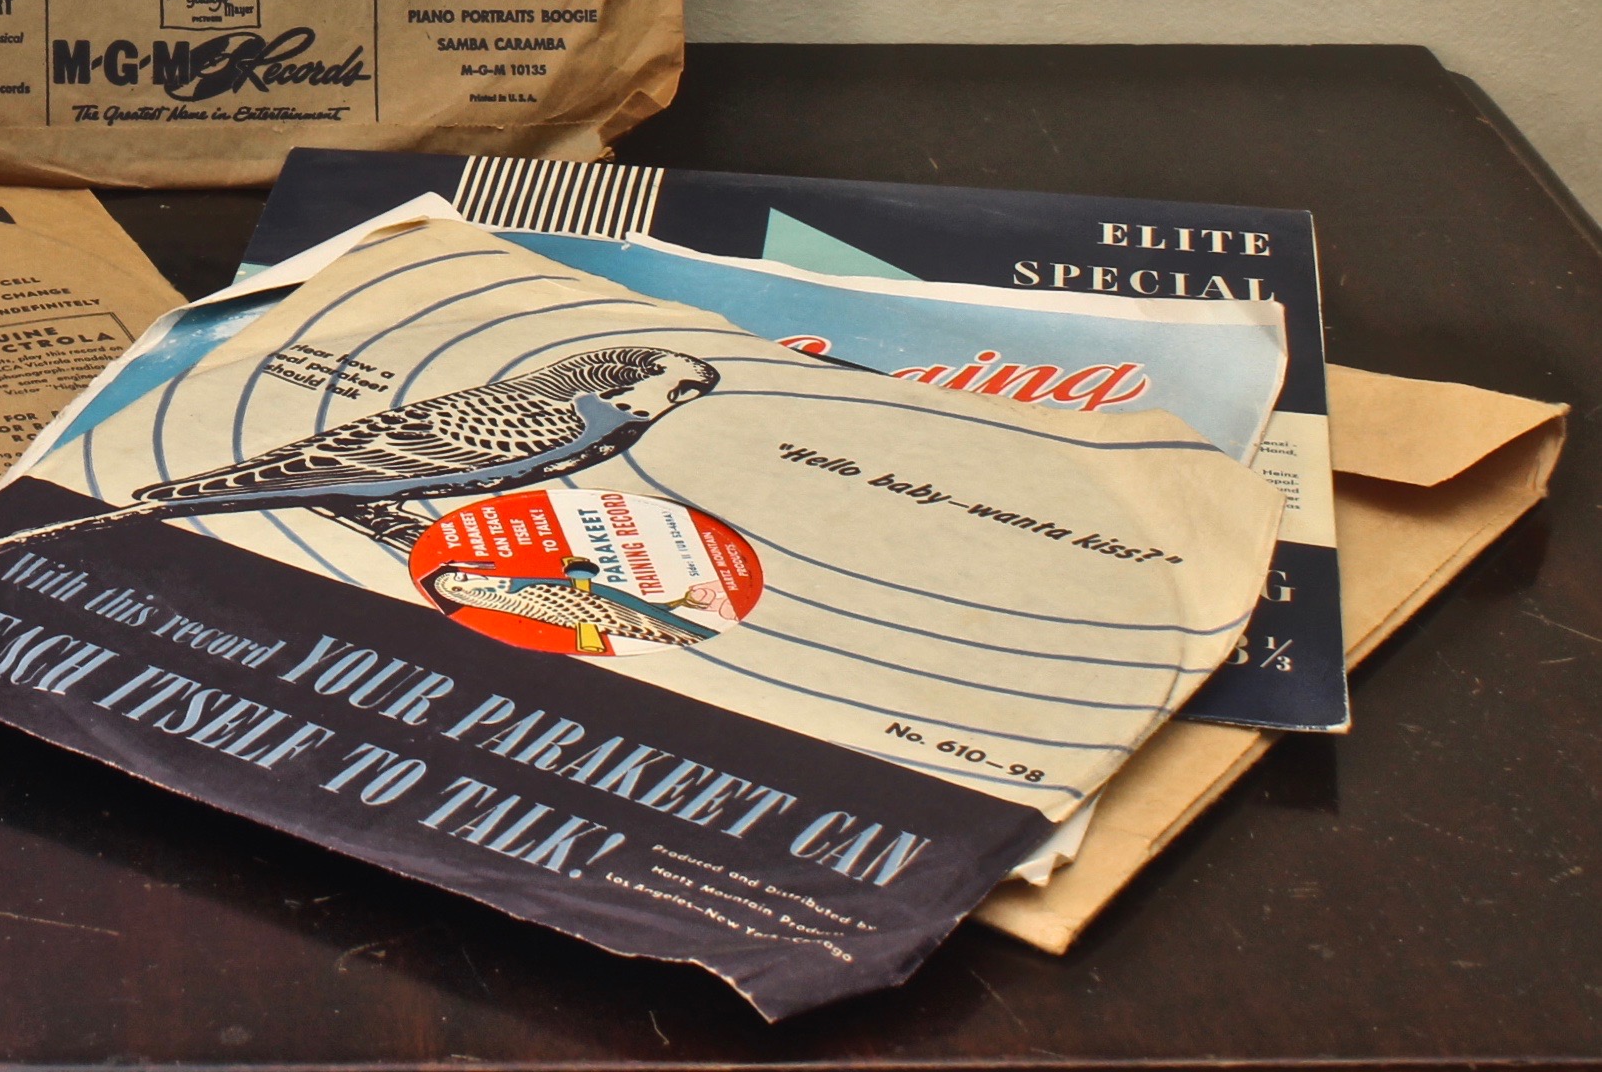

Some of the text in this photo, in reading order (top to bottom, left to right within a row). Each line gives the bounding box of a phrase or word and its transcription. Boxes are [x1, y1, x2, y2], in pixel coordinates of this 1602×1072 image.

[52, 27, 372, 102] M-G-M Records
[71, 104, 351, 127] The Greatest Name in Entertainment
[1097, 221, 1273, 257] ELITE
[0, 276, 41, 287] CELL
[1, 287, 72, 301] CHANGE
[1012, 259, 1276, 302] SPECIAL
[264, 363, 361, 400] should talk
[267, 352, 389, 392] real parakeet
[289, 344, 396, 380] Hear how a
[2, 413, 39, 423] FOR
[440, 521, 462, 549] YOUR
[460, 511, 489, 558] PARAKEET
[481, 506, 514, 559] CAN TEACH
[509, 518, 534, 547] ITSELF
[530, 508, 560, 553] TO TALK!
[578, 508, 628, 584] PARAKEET
[600, 493, 666, 596] TRAINING RECORD
[0, 551, 933, 889] With this record YOUR PARAKEET CAN
[883, 721, 927, 746] No.
[92, 665, 336, 771] ITSELF
[318, 741, 427, 807] TO
[417, 776, 626, 879] TALK!
[651, 844, 853, 926] Produced and Distributed
[651, 865, 774, 916] Hartz Mountain
